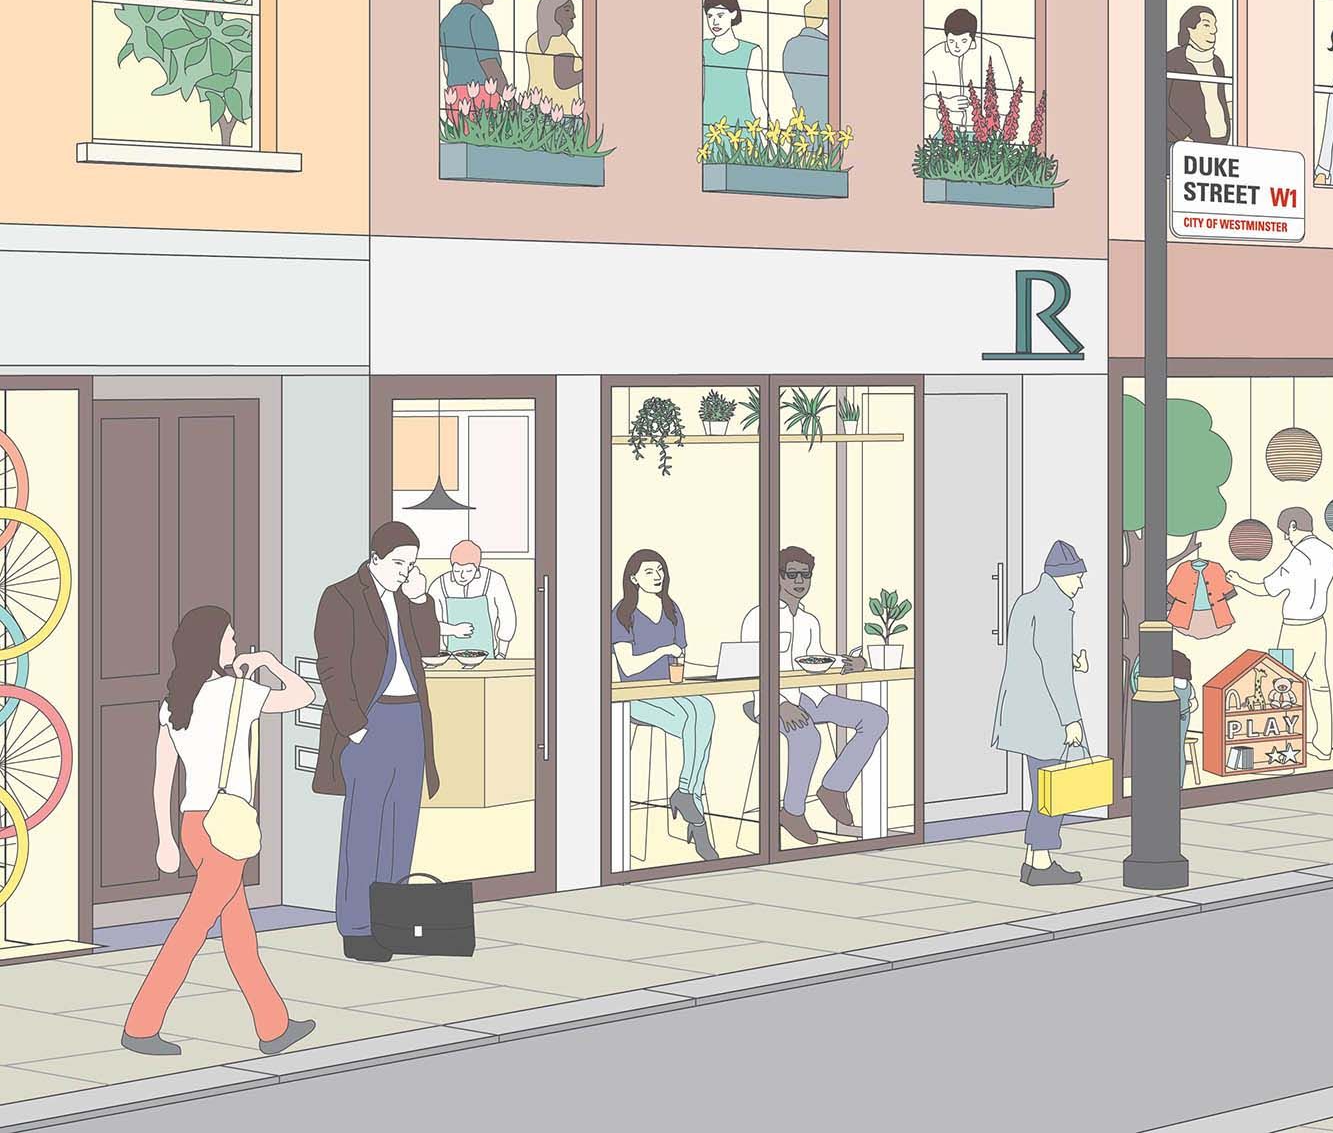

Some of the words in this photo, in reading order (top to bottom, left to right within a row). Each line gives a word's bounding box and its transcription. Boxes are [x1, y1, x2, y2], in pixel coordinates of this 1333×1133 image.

[1183, 155, 1239, 178] DUKE
[1183, 181, 1260, 205] STREET
[1270, 187, 1297, 208] W1
[1183, 216, 1204, 228] CITY
[1206, 218, 1218, 229] OF
[1219, 219, 1288, 233] WESTMINSTER
[1014, 269, 1085, 355] R
[1227, 715, 1300, 739] PLAY
